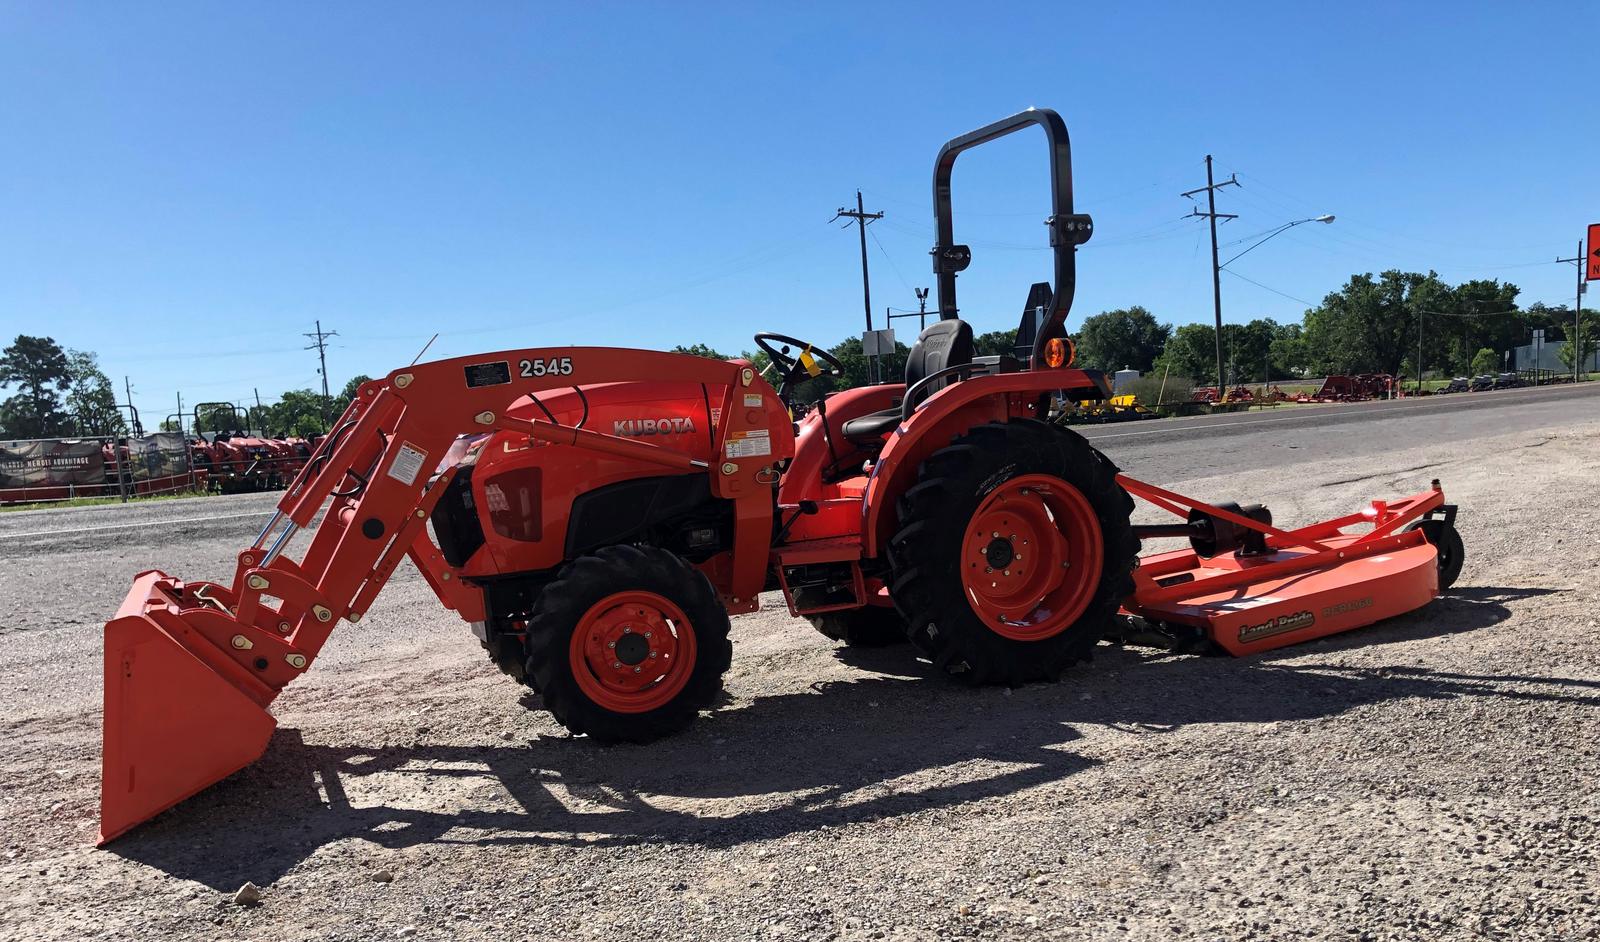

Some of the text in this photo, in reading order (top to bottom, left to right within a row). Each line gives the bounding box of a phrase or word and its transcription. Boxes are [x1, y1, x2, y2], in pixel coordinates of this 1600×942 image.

[519, 358, 573, 378] 2545
[613, 418, 696, 437] KUBOTA
[53, 457, 89, 465] ADVANTAGE
[1240, 610, 1314, 635] Land Pride
